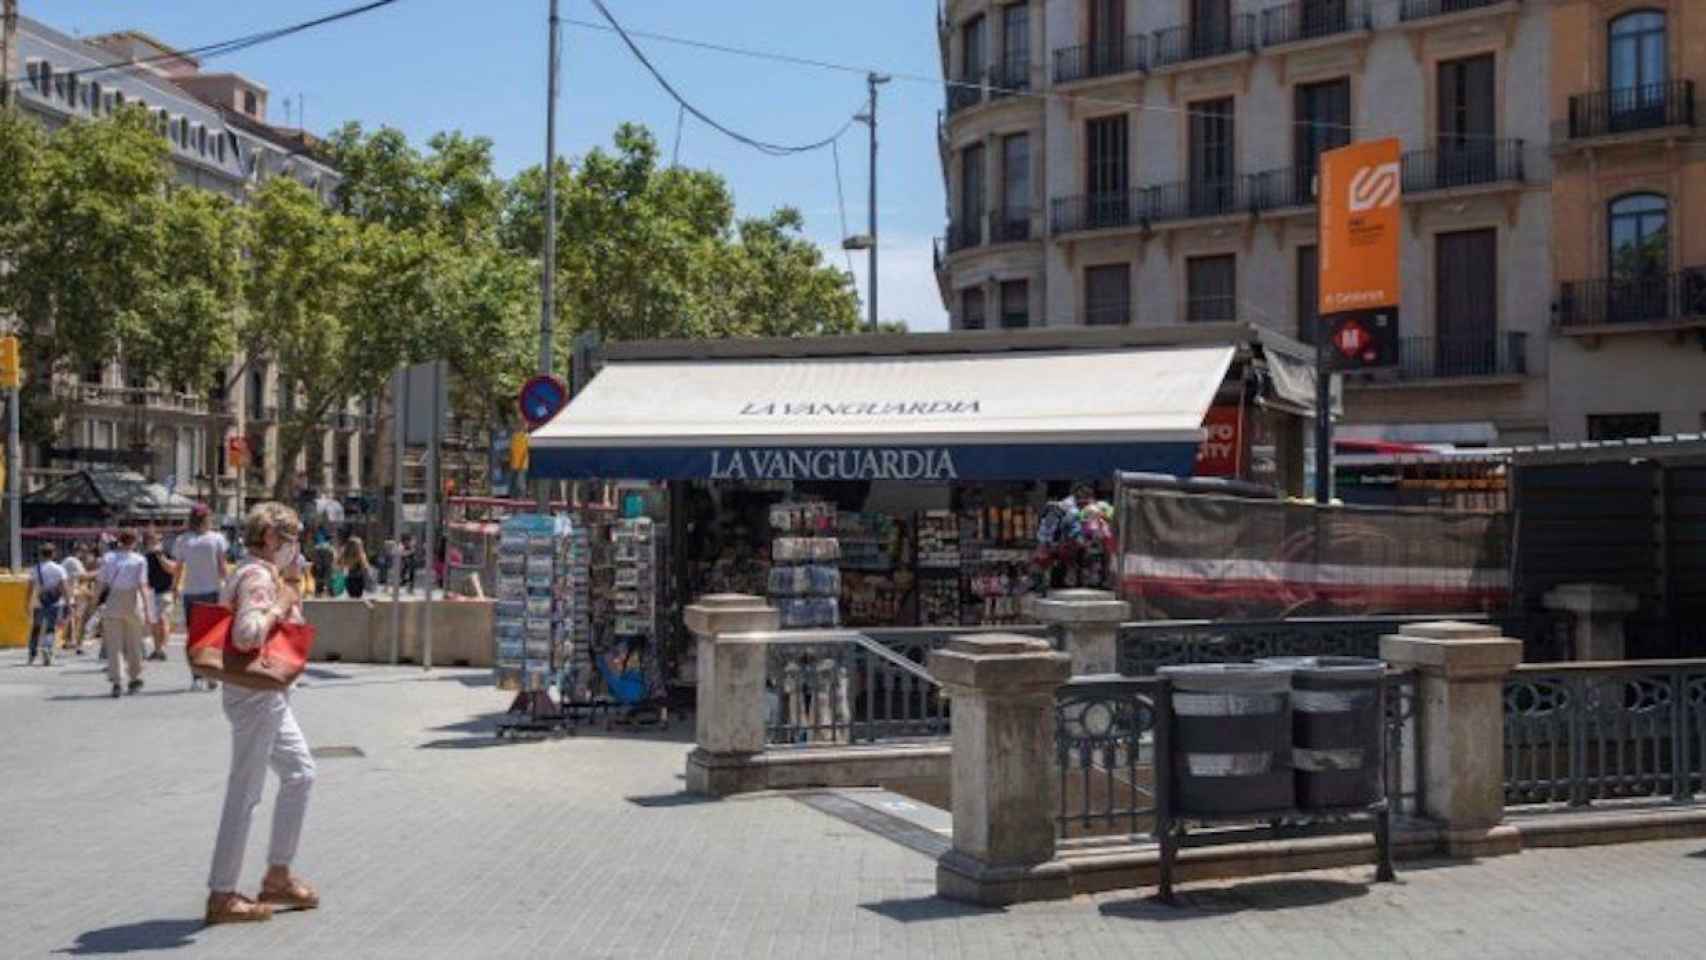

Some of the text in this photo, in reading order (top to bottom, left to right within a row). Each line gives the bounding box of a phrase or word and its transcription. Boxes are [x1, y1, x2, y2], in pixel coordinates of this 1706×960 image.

[740, 401, 981, 415] LA VANGUARDIA
[709, 449, 958, 479] LA VANGUARDIA
